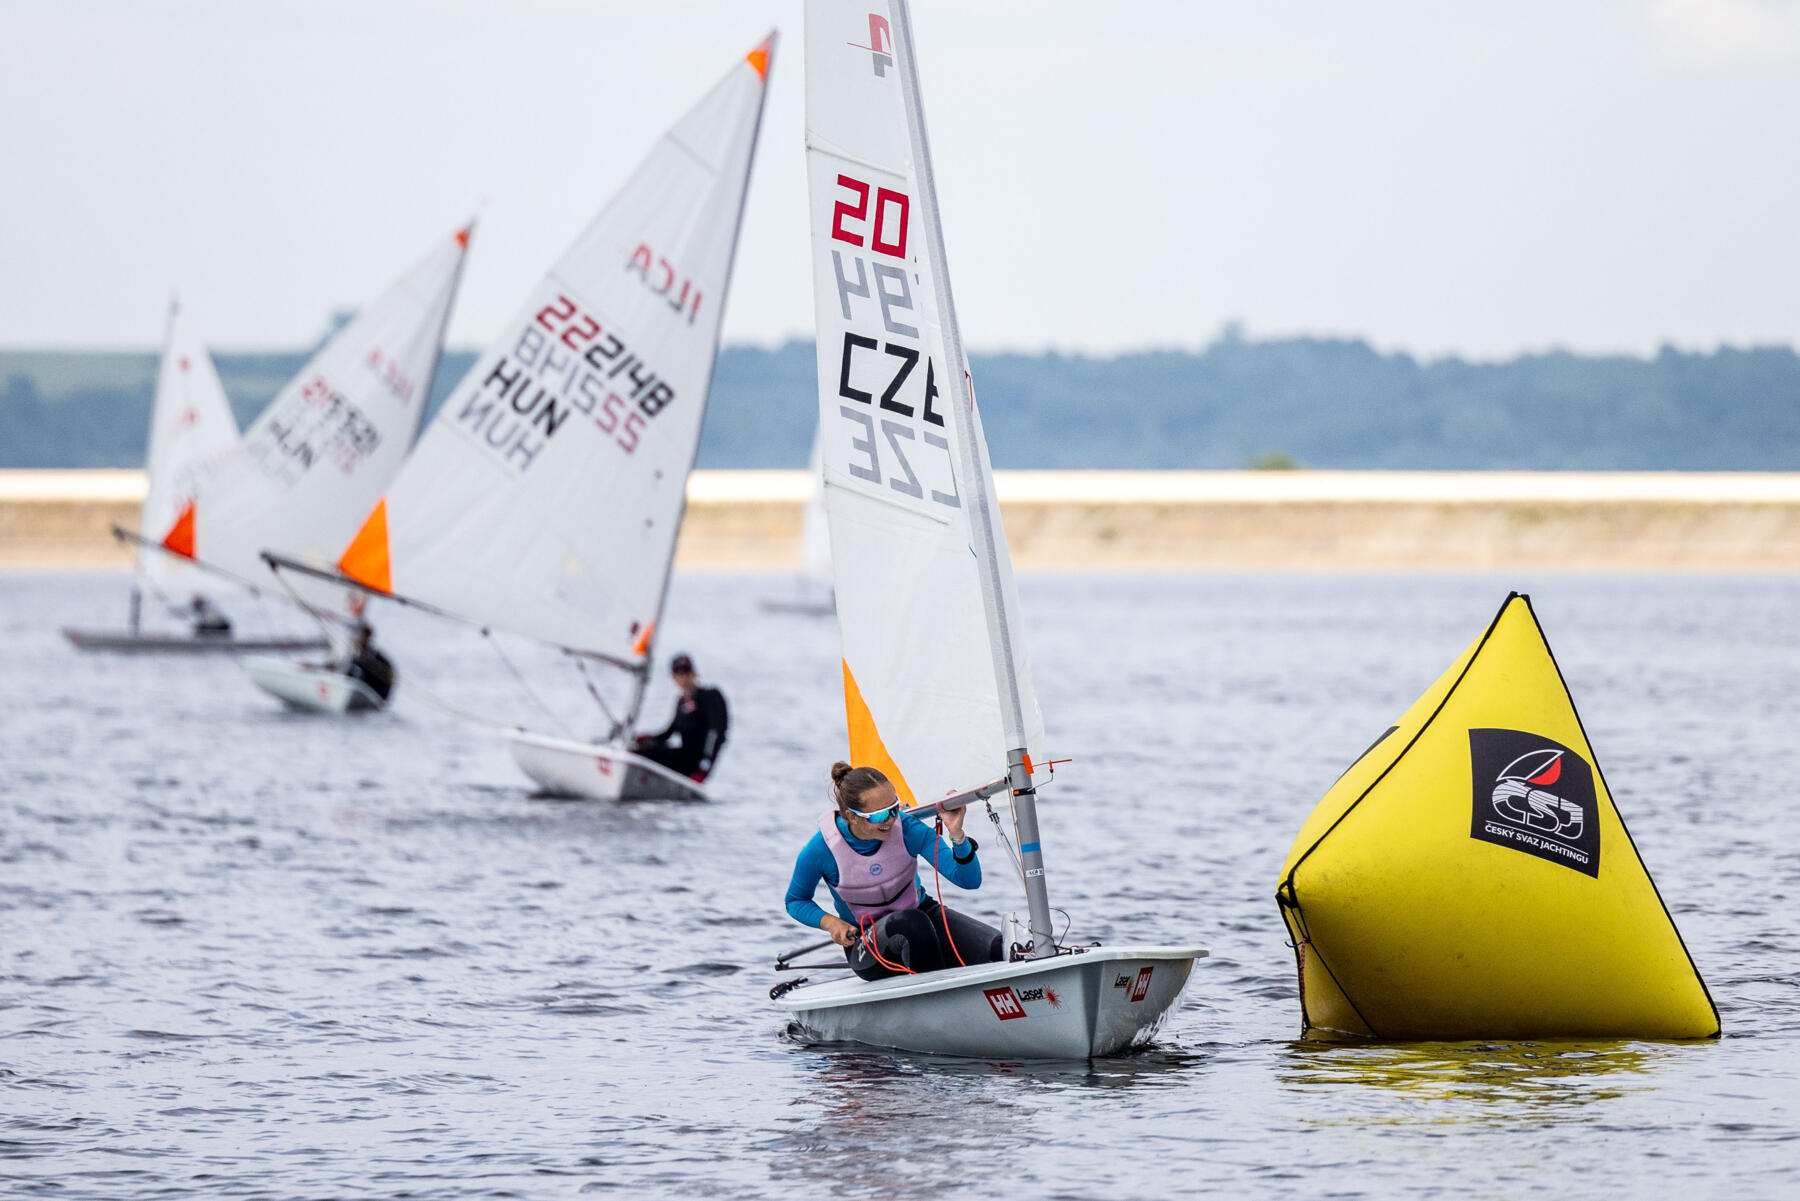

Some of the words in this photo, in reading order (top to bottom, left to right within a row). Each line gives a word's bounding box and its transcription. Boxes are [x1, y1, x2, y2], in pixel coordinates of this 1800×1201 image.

[832, 174, 917, 263] 20
[535, 294, 676, 419] 222148
[839, 331, 945, 427] CZE
[484, 358, 570, 437] HUN
[1485, 823, 1515, 838] ČESKÝ
[1516, 832, 1540, 846] SVAZ
[1540, 840, 1589, 864] JACHTINGU
[989, 992, 1020, 1015] HH
[1016, 988, 1044, 1001] Laser
